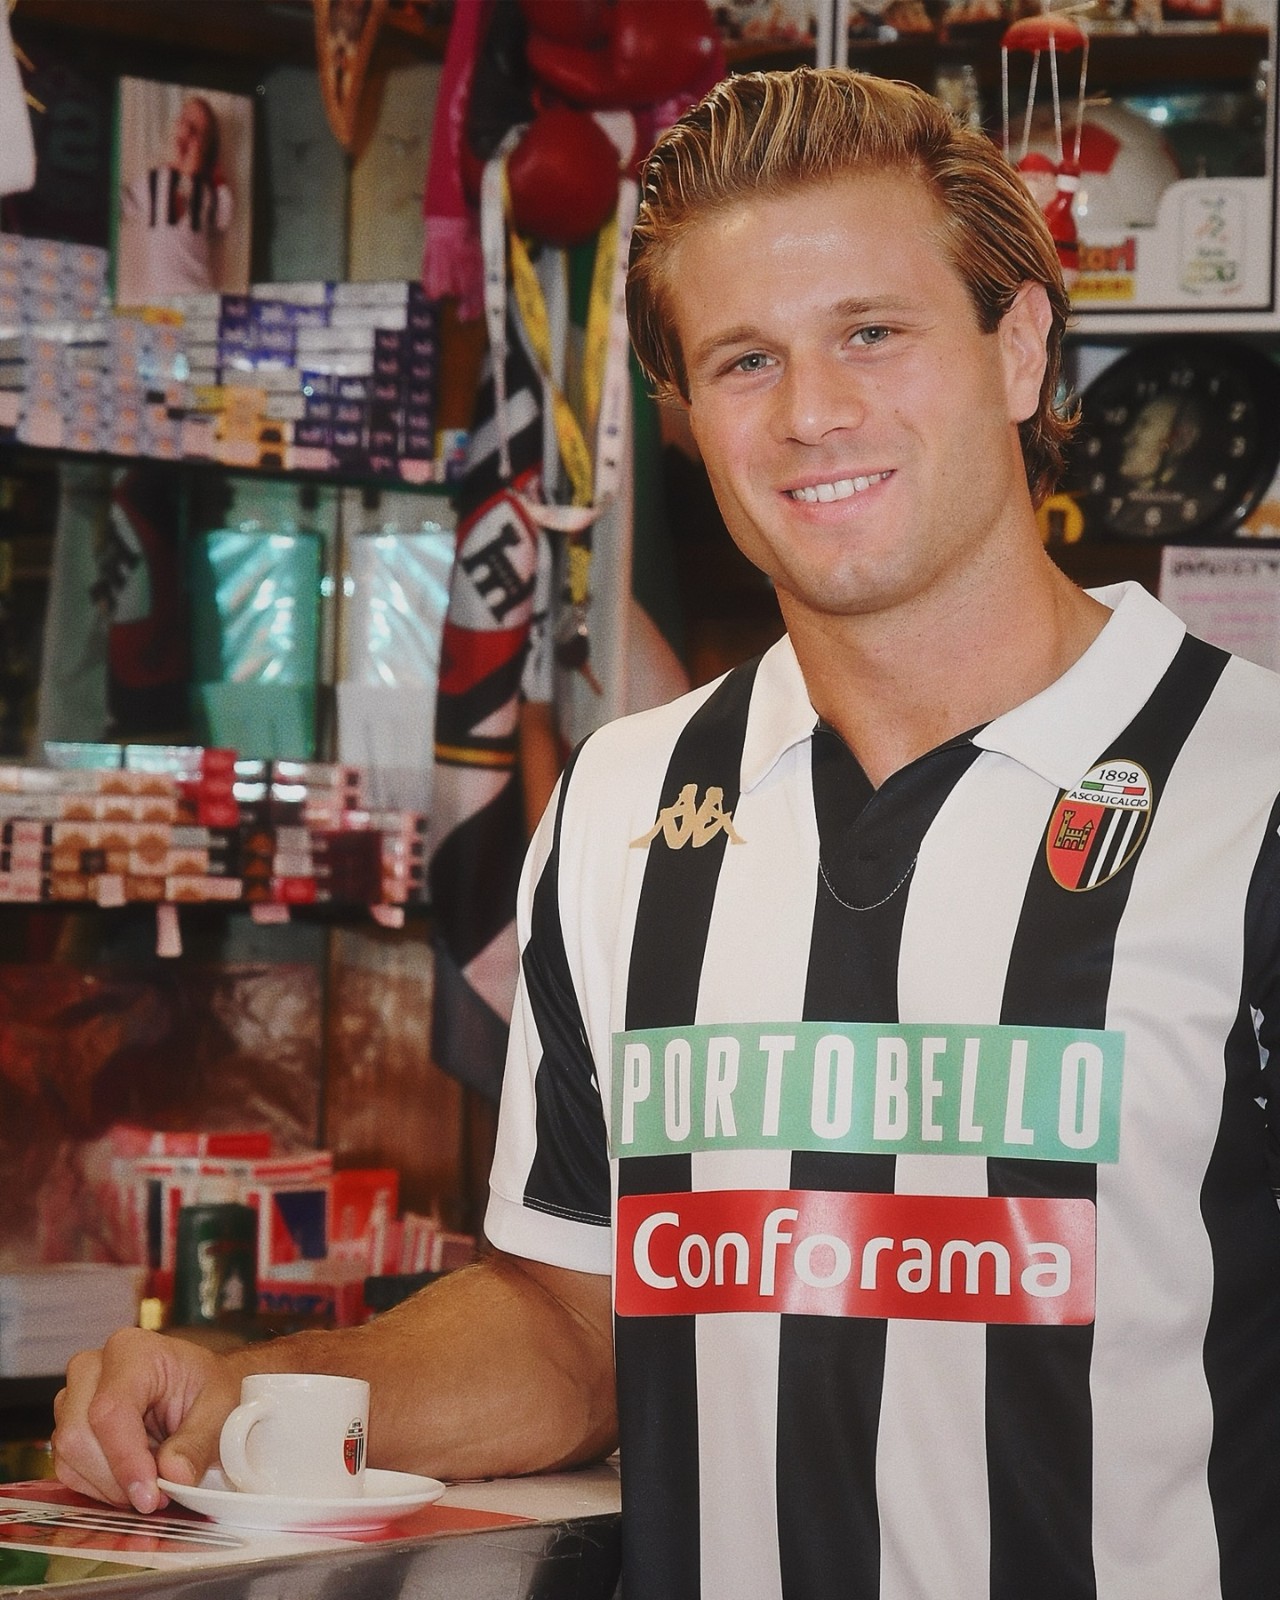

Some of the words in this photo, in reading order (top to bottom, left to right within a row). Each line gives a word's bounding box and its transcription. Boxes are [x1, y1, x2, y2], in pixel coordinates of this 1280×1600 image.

[1099, 769, 1139, 784] 1898
[621, 1034, 1104, 1150] PORTOBELLO
[632, 1207, 1073, 1298] Conforama
